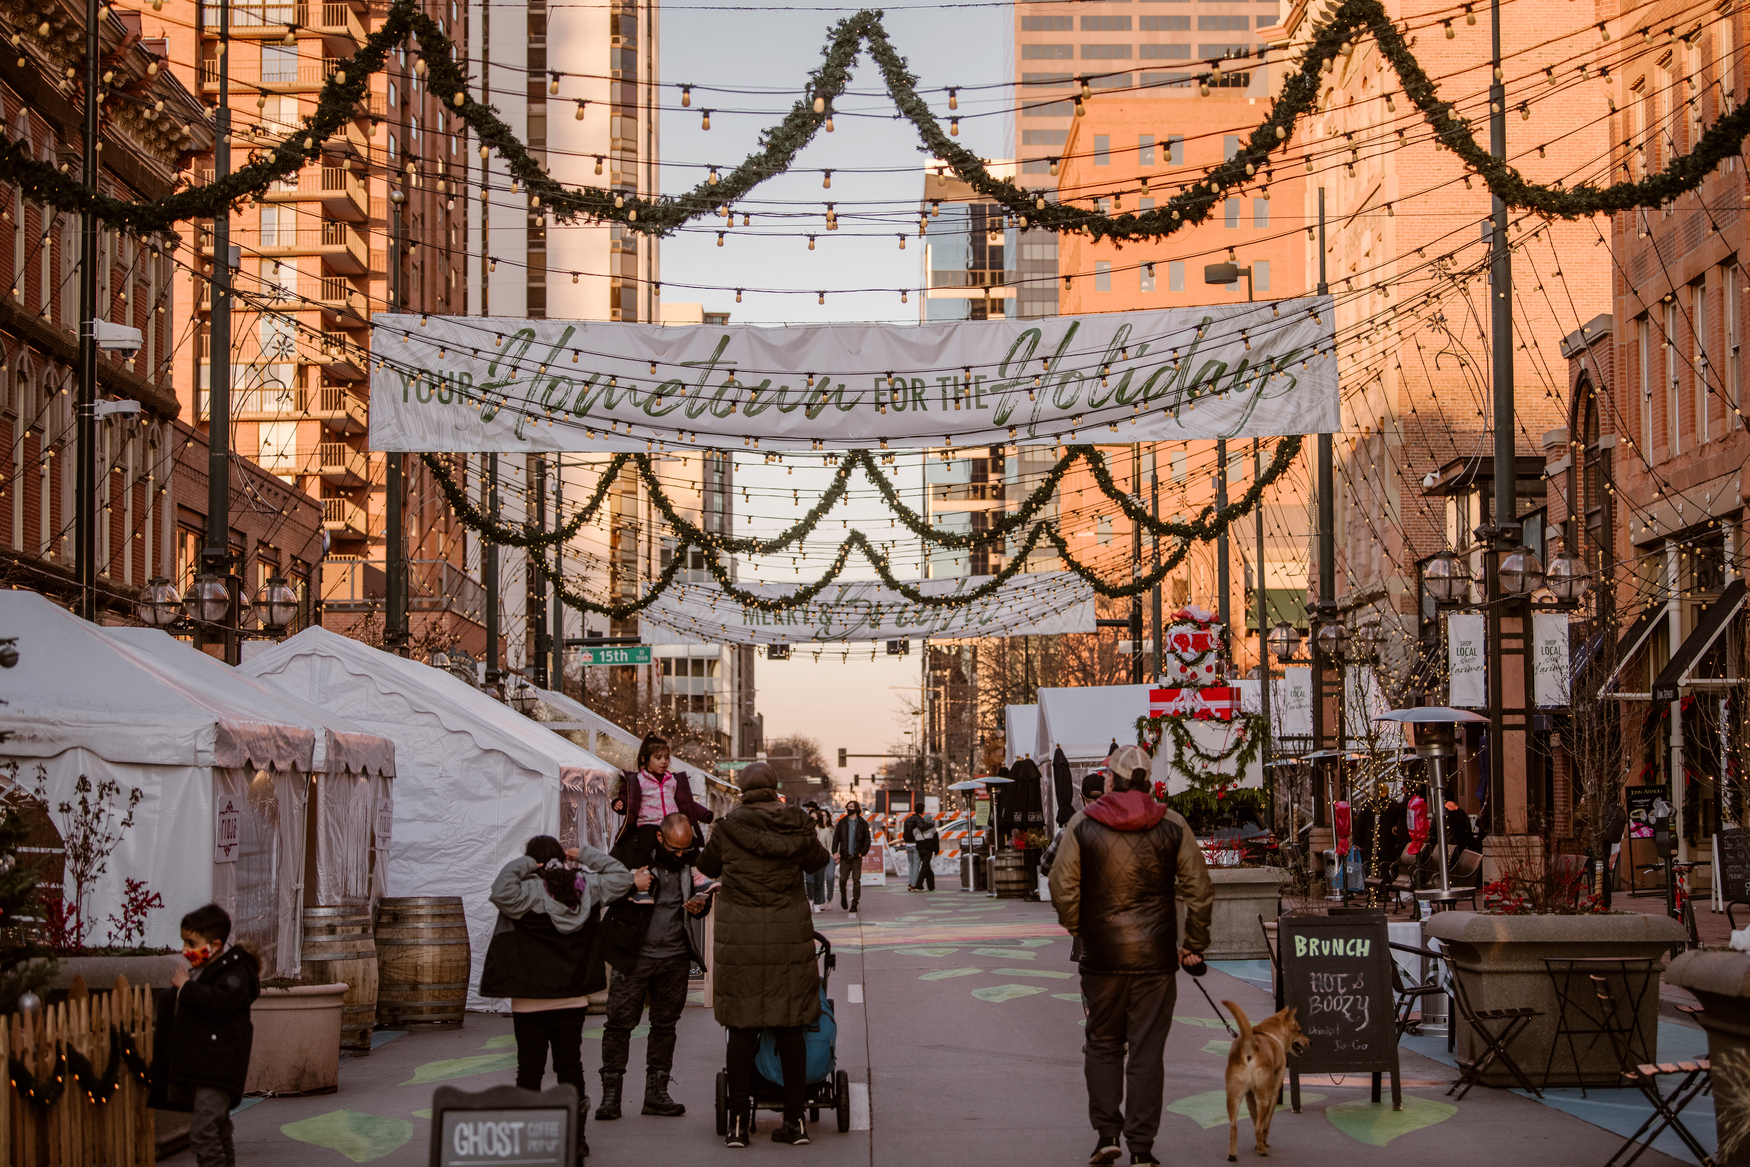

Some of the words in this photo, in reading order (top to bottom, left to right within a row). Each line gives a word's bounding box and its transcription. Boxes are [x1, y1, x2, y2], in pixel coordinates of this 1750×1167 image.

[399, 368, 475, 405] YOUR
[479, 325, 867, 441] Hometown
[874, 376, 928, 412] FOR
[936, 374, 989, 411] THE
[989, 316, 1305, 440] Holidays
[742, 602, 811, 626] MERRY
[599, 650, 628, 662] 15th
[1456, 647, 1477, 656] LOCAL
[1541, 646, 1563, 656] LOCAL
[1294, 935, 1370, 957] BRUNCH
[1310, 972, 1348, 995] HOT
[1308, 995, 1370, 1031] BOOZY
[453, 1121, 525, 1158] GHOST
